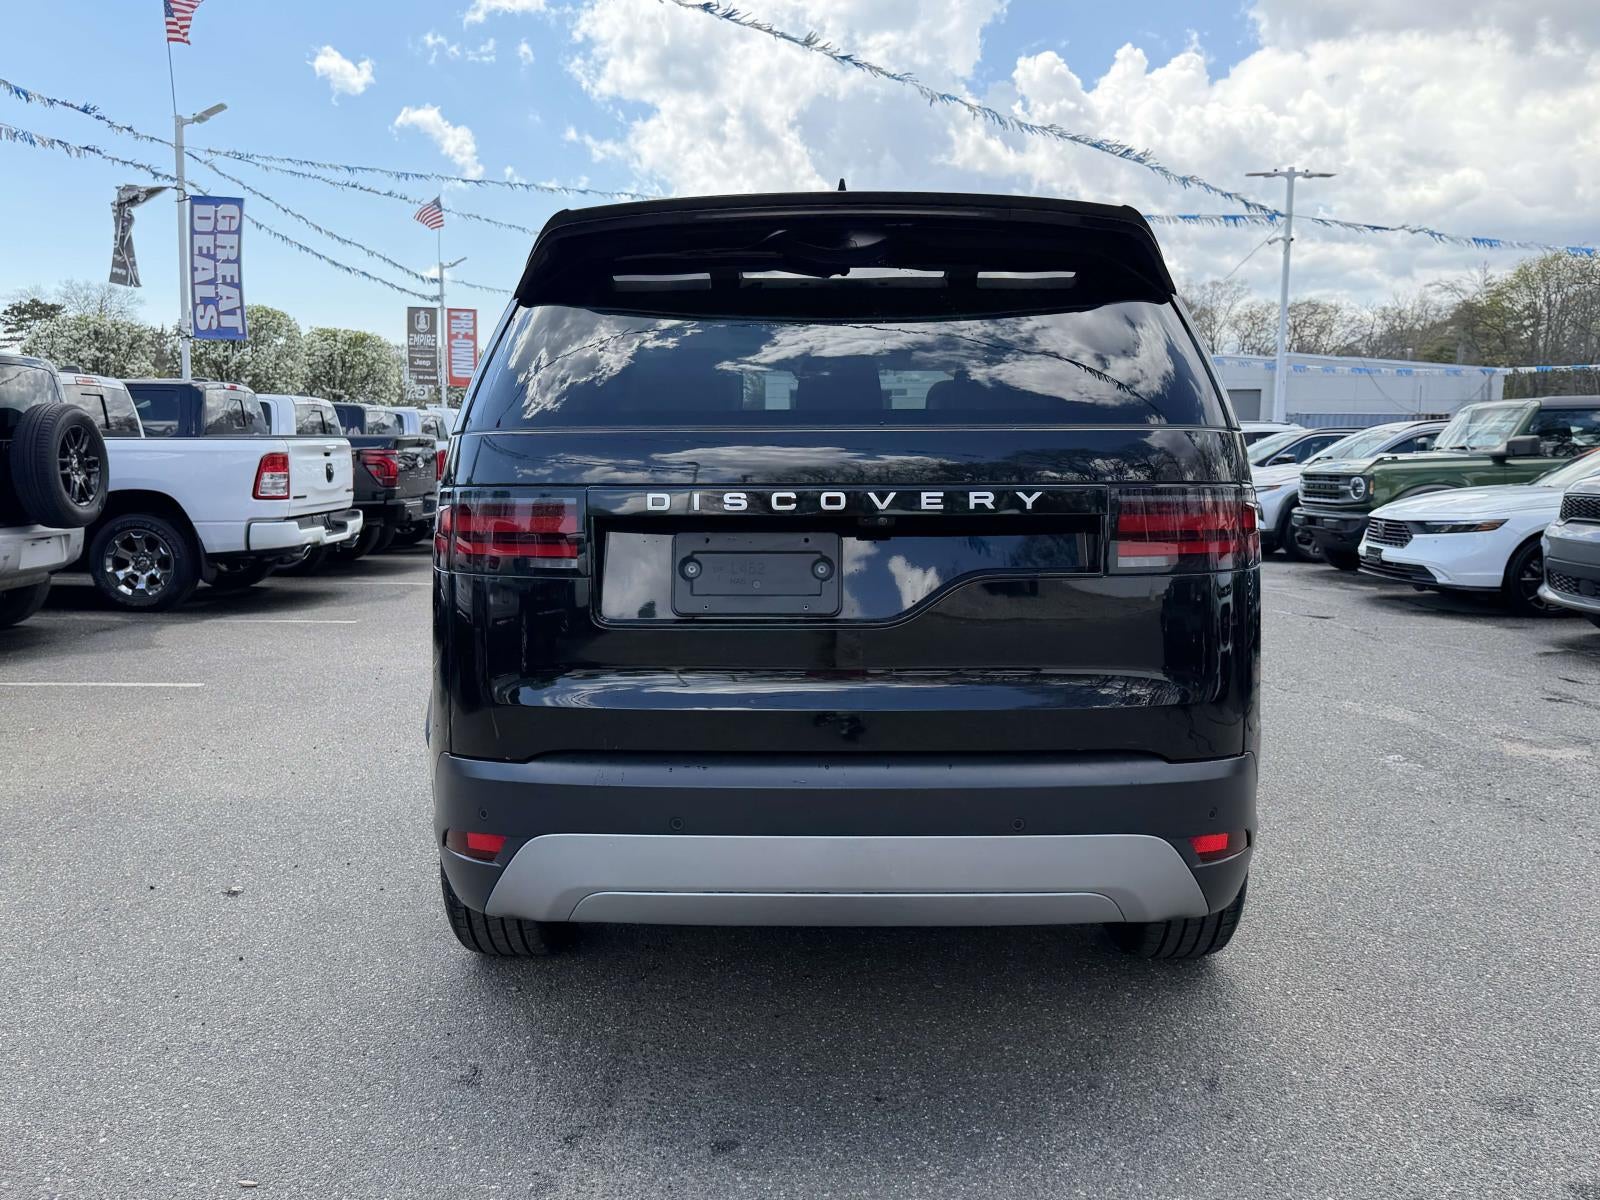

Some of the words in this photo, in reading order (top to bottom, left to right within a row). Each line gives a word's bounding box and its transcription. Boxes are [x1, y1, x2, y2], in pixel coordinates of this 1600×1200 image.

[193, 204, 218, 331] DEALS
[216, 204, 243, 334] GREAT
[409, 333, 436, 346] EMPIRE
[414, 359, 431, 367] Jeep
[646, 491, 1043, 511] DISCOVERY
